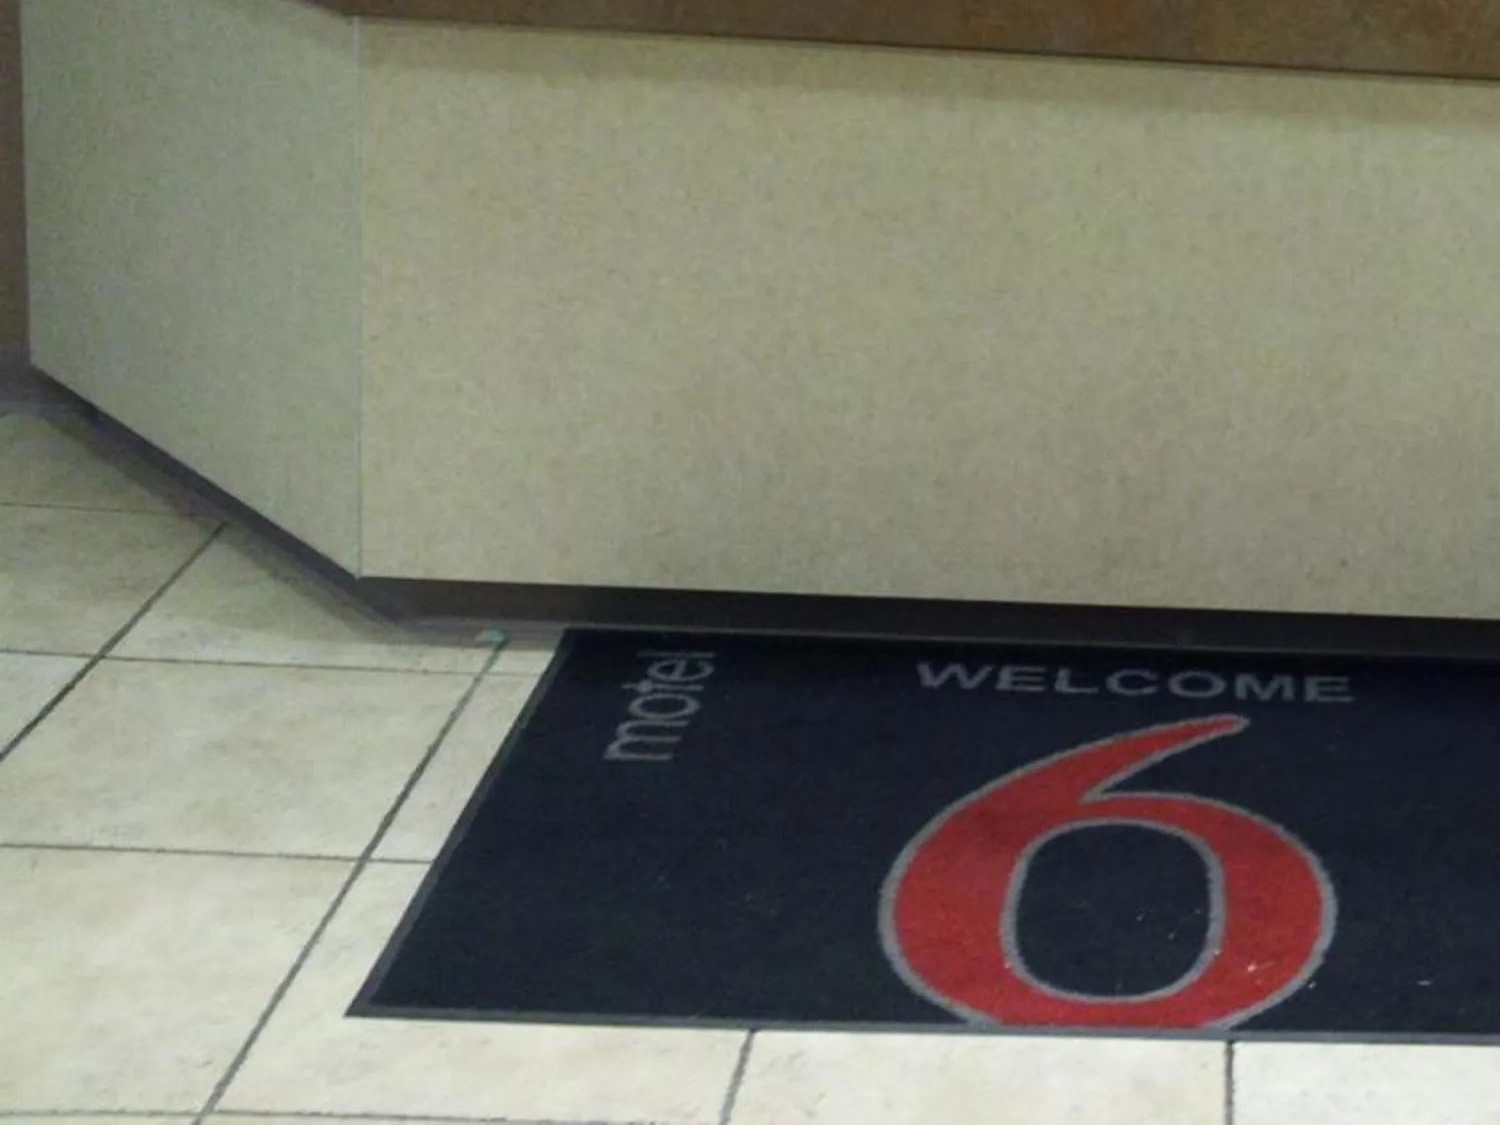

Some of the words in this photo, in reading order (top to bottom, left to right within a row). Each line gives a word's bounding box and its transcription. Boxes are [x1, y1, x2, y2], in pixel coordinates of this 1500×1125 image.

[916, 662, 1356, 703] WELCOME
[603, 651, 716, 761] motel
[878, 713, 1338, 1030] 6
